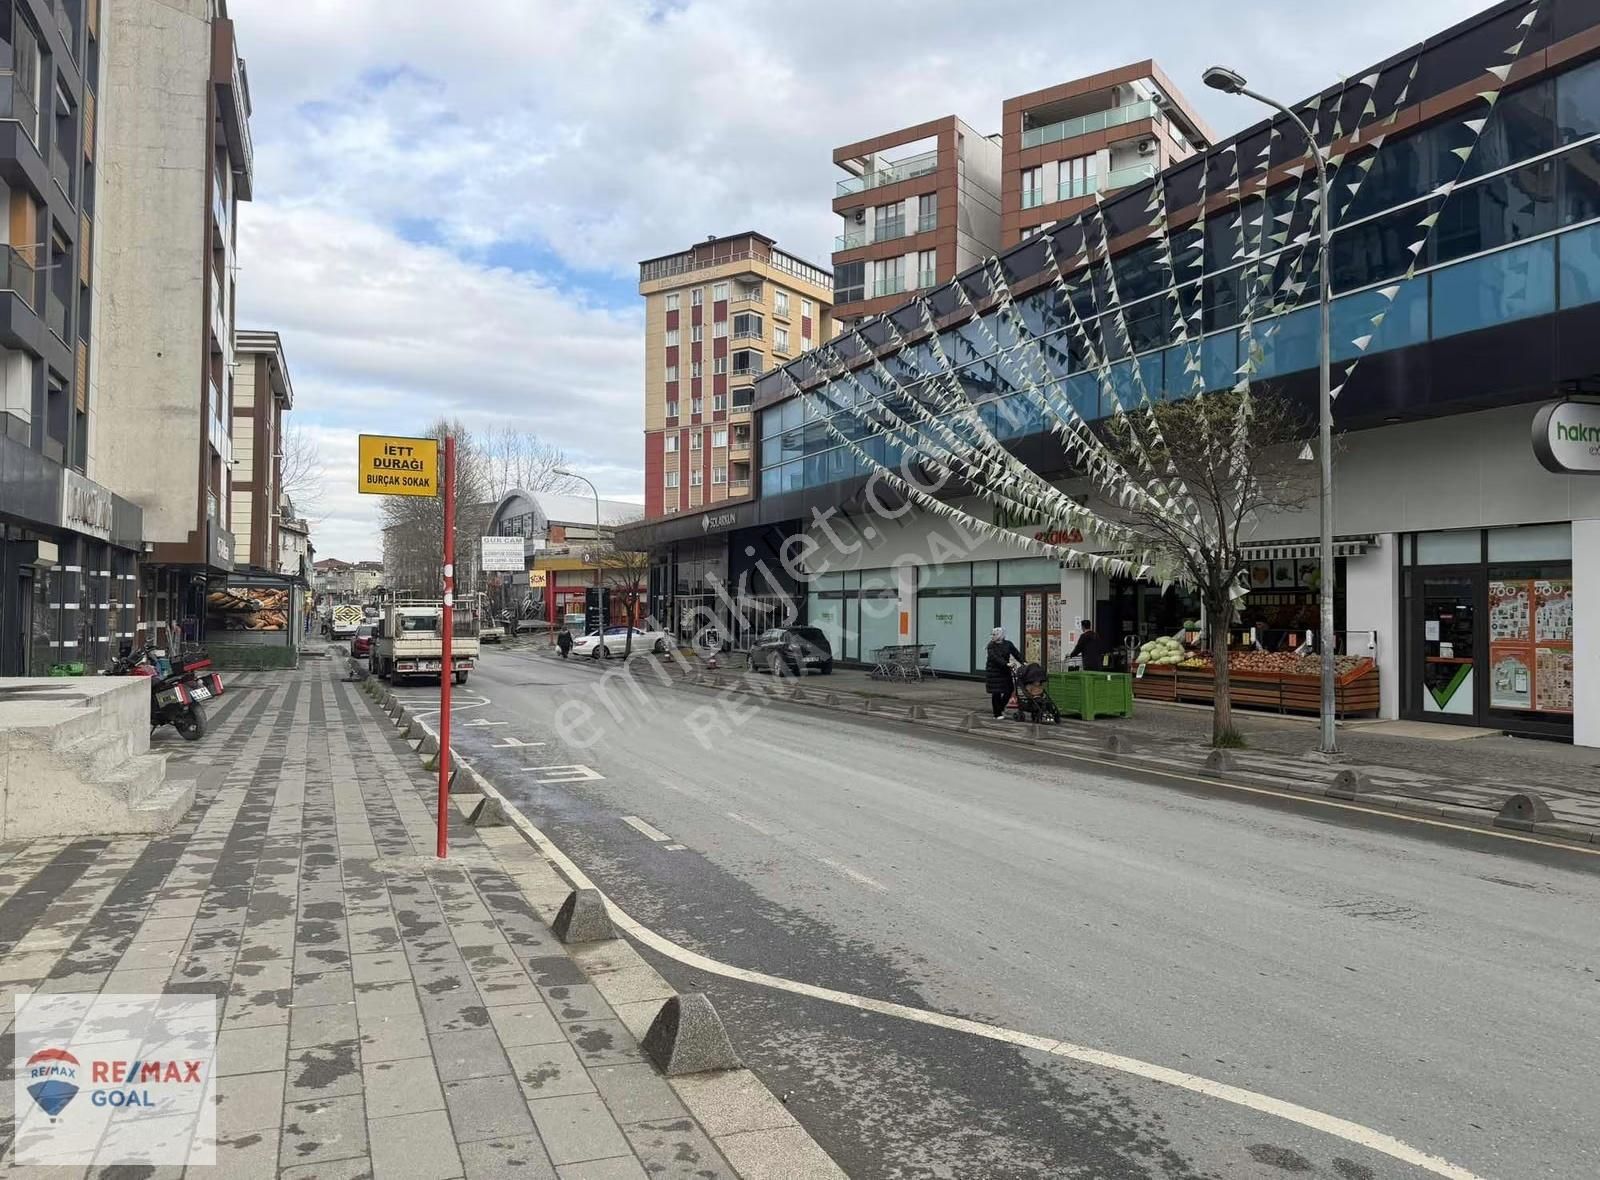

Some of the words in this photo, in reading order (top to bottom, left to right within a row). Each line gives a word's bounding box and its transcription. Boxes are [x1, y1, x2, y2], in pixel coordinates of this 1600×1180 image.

[384, 443, 414, 457] İETT
[373, 457, 424, 470] DURAĞI
[367, 474, 400, 487] BURÇAK
[402, 476, 430, 487] SOKAK
